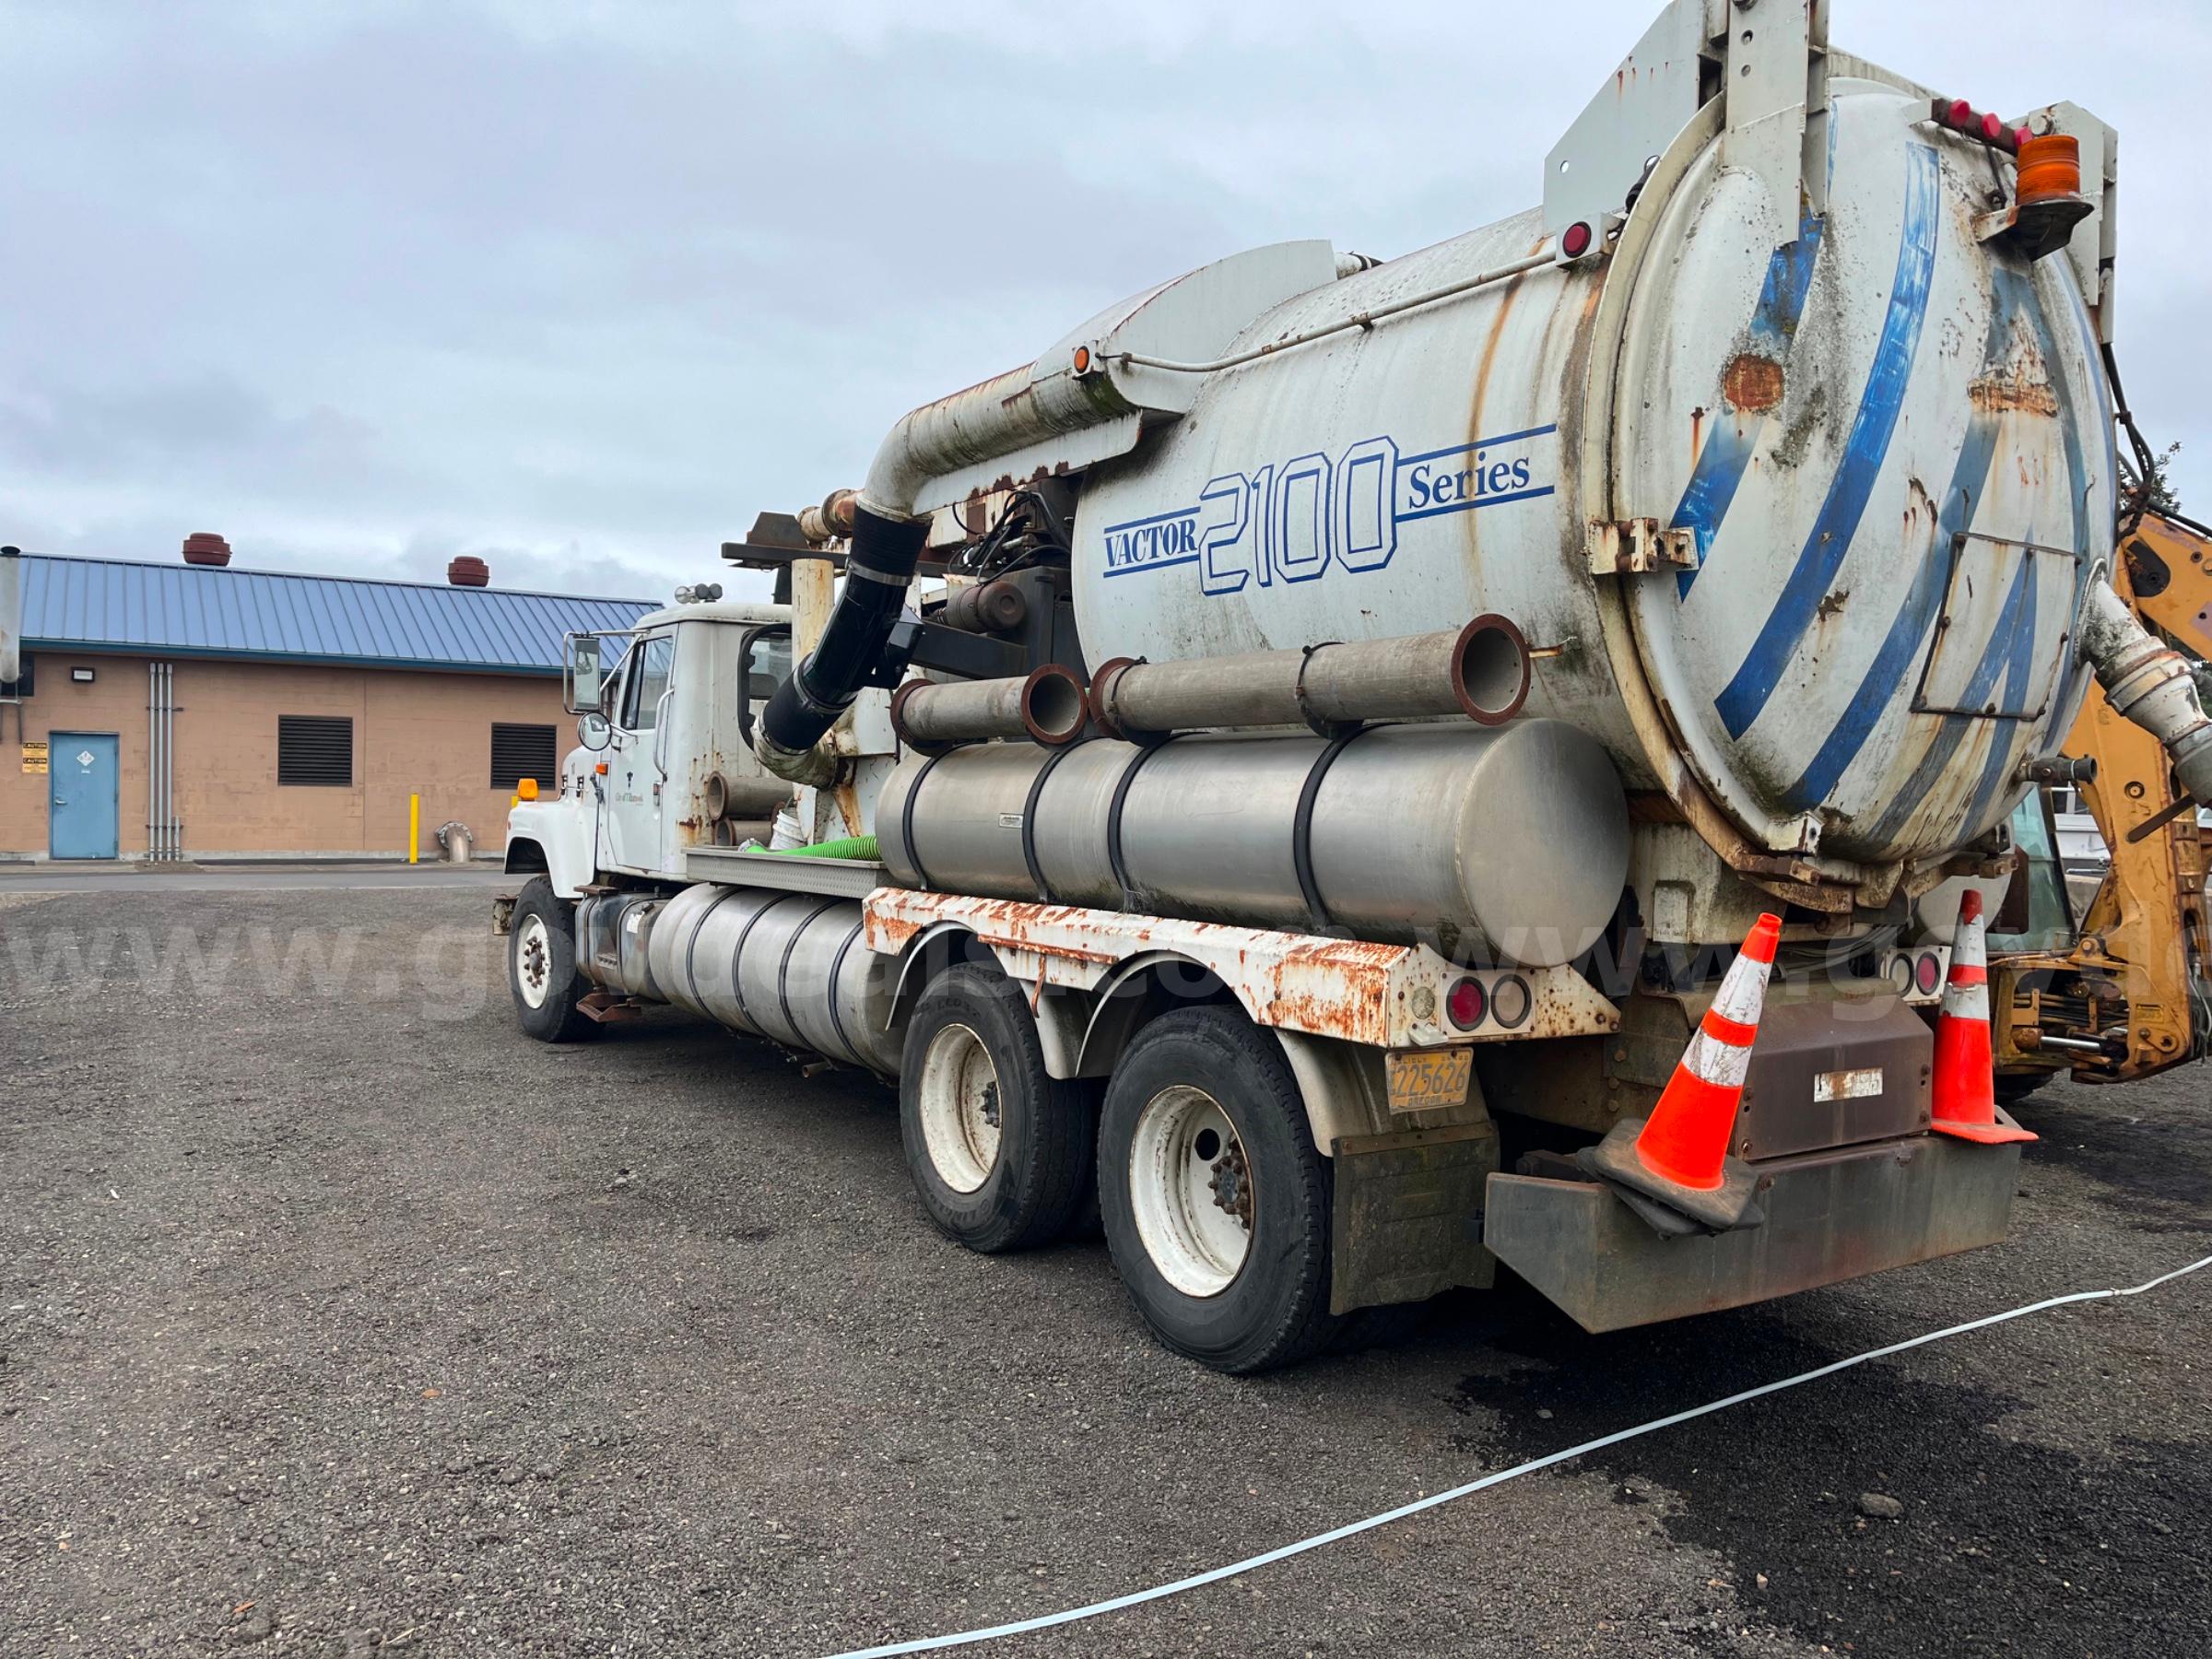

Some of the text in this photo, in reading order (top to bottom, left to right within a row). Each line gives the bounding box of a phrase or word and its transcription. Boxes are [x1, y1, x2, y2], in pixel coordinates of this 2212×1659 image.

[1105, 436, 1530, 595] VACTOR 2100 Series
